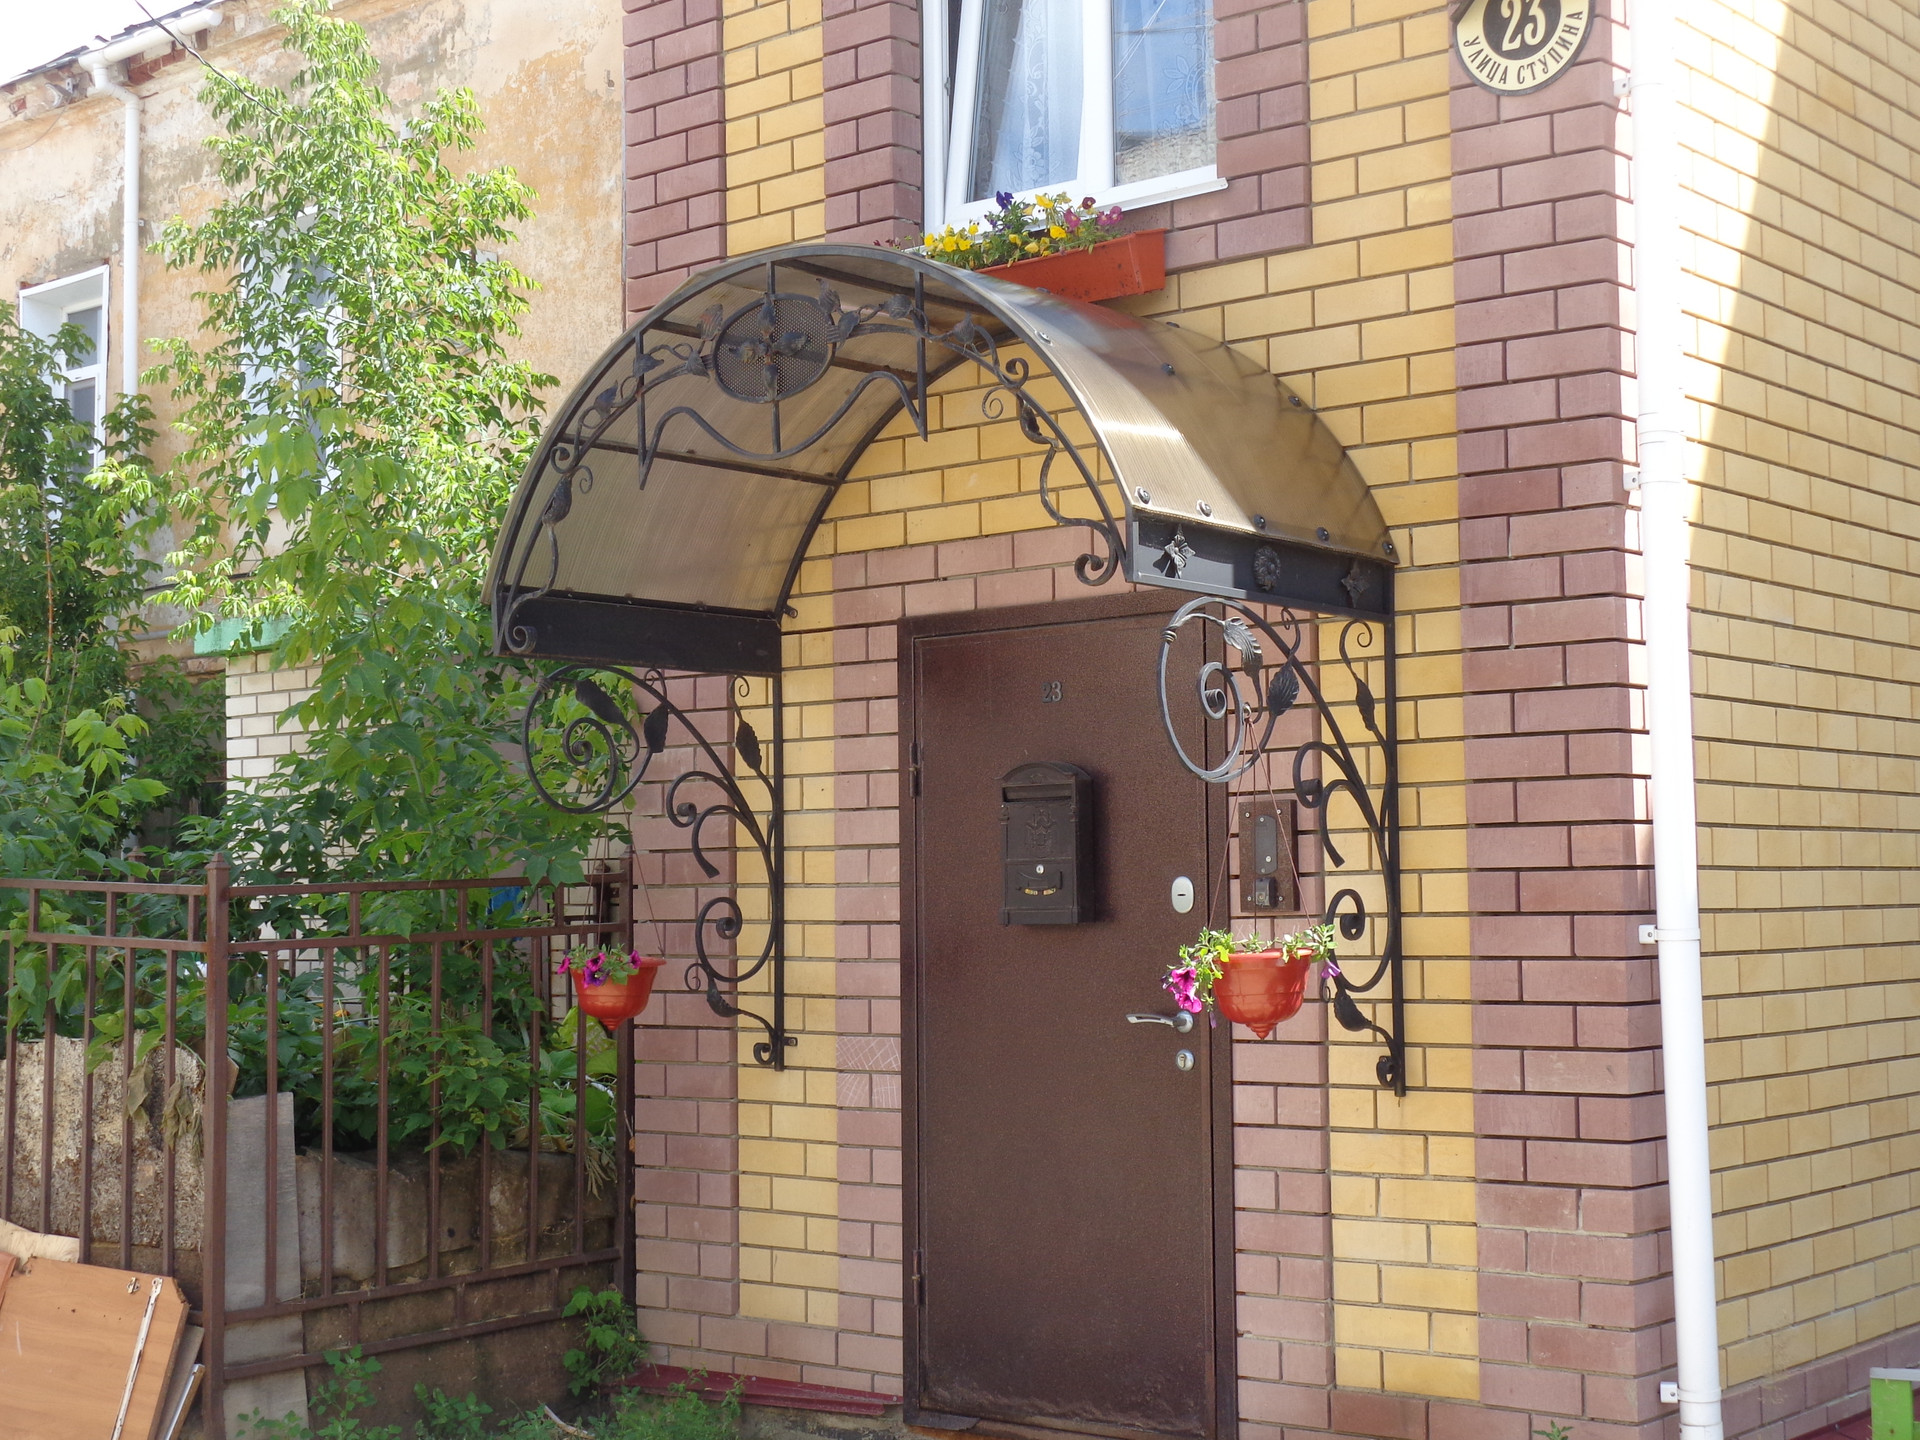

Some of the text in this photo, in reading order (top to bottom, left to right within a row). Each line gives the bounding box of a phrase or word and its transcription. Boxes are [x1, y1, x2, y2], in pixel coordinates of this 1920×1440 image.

[1463, 10, 1583, 85] УЛИЦА СТУПИНА
[1500, 0, 1546, 51] 23
[1041, 681, 1063, 703] 23
